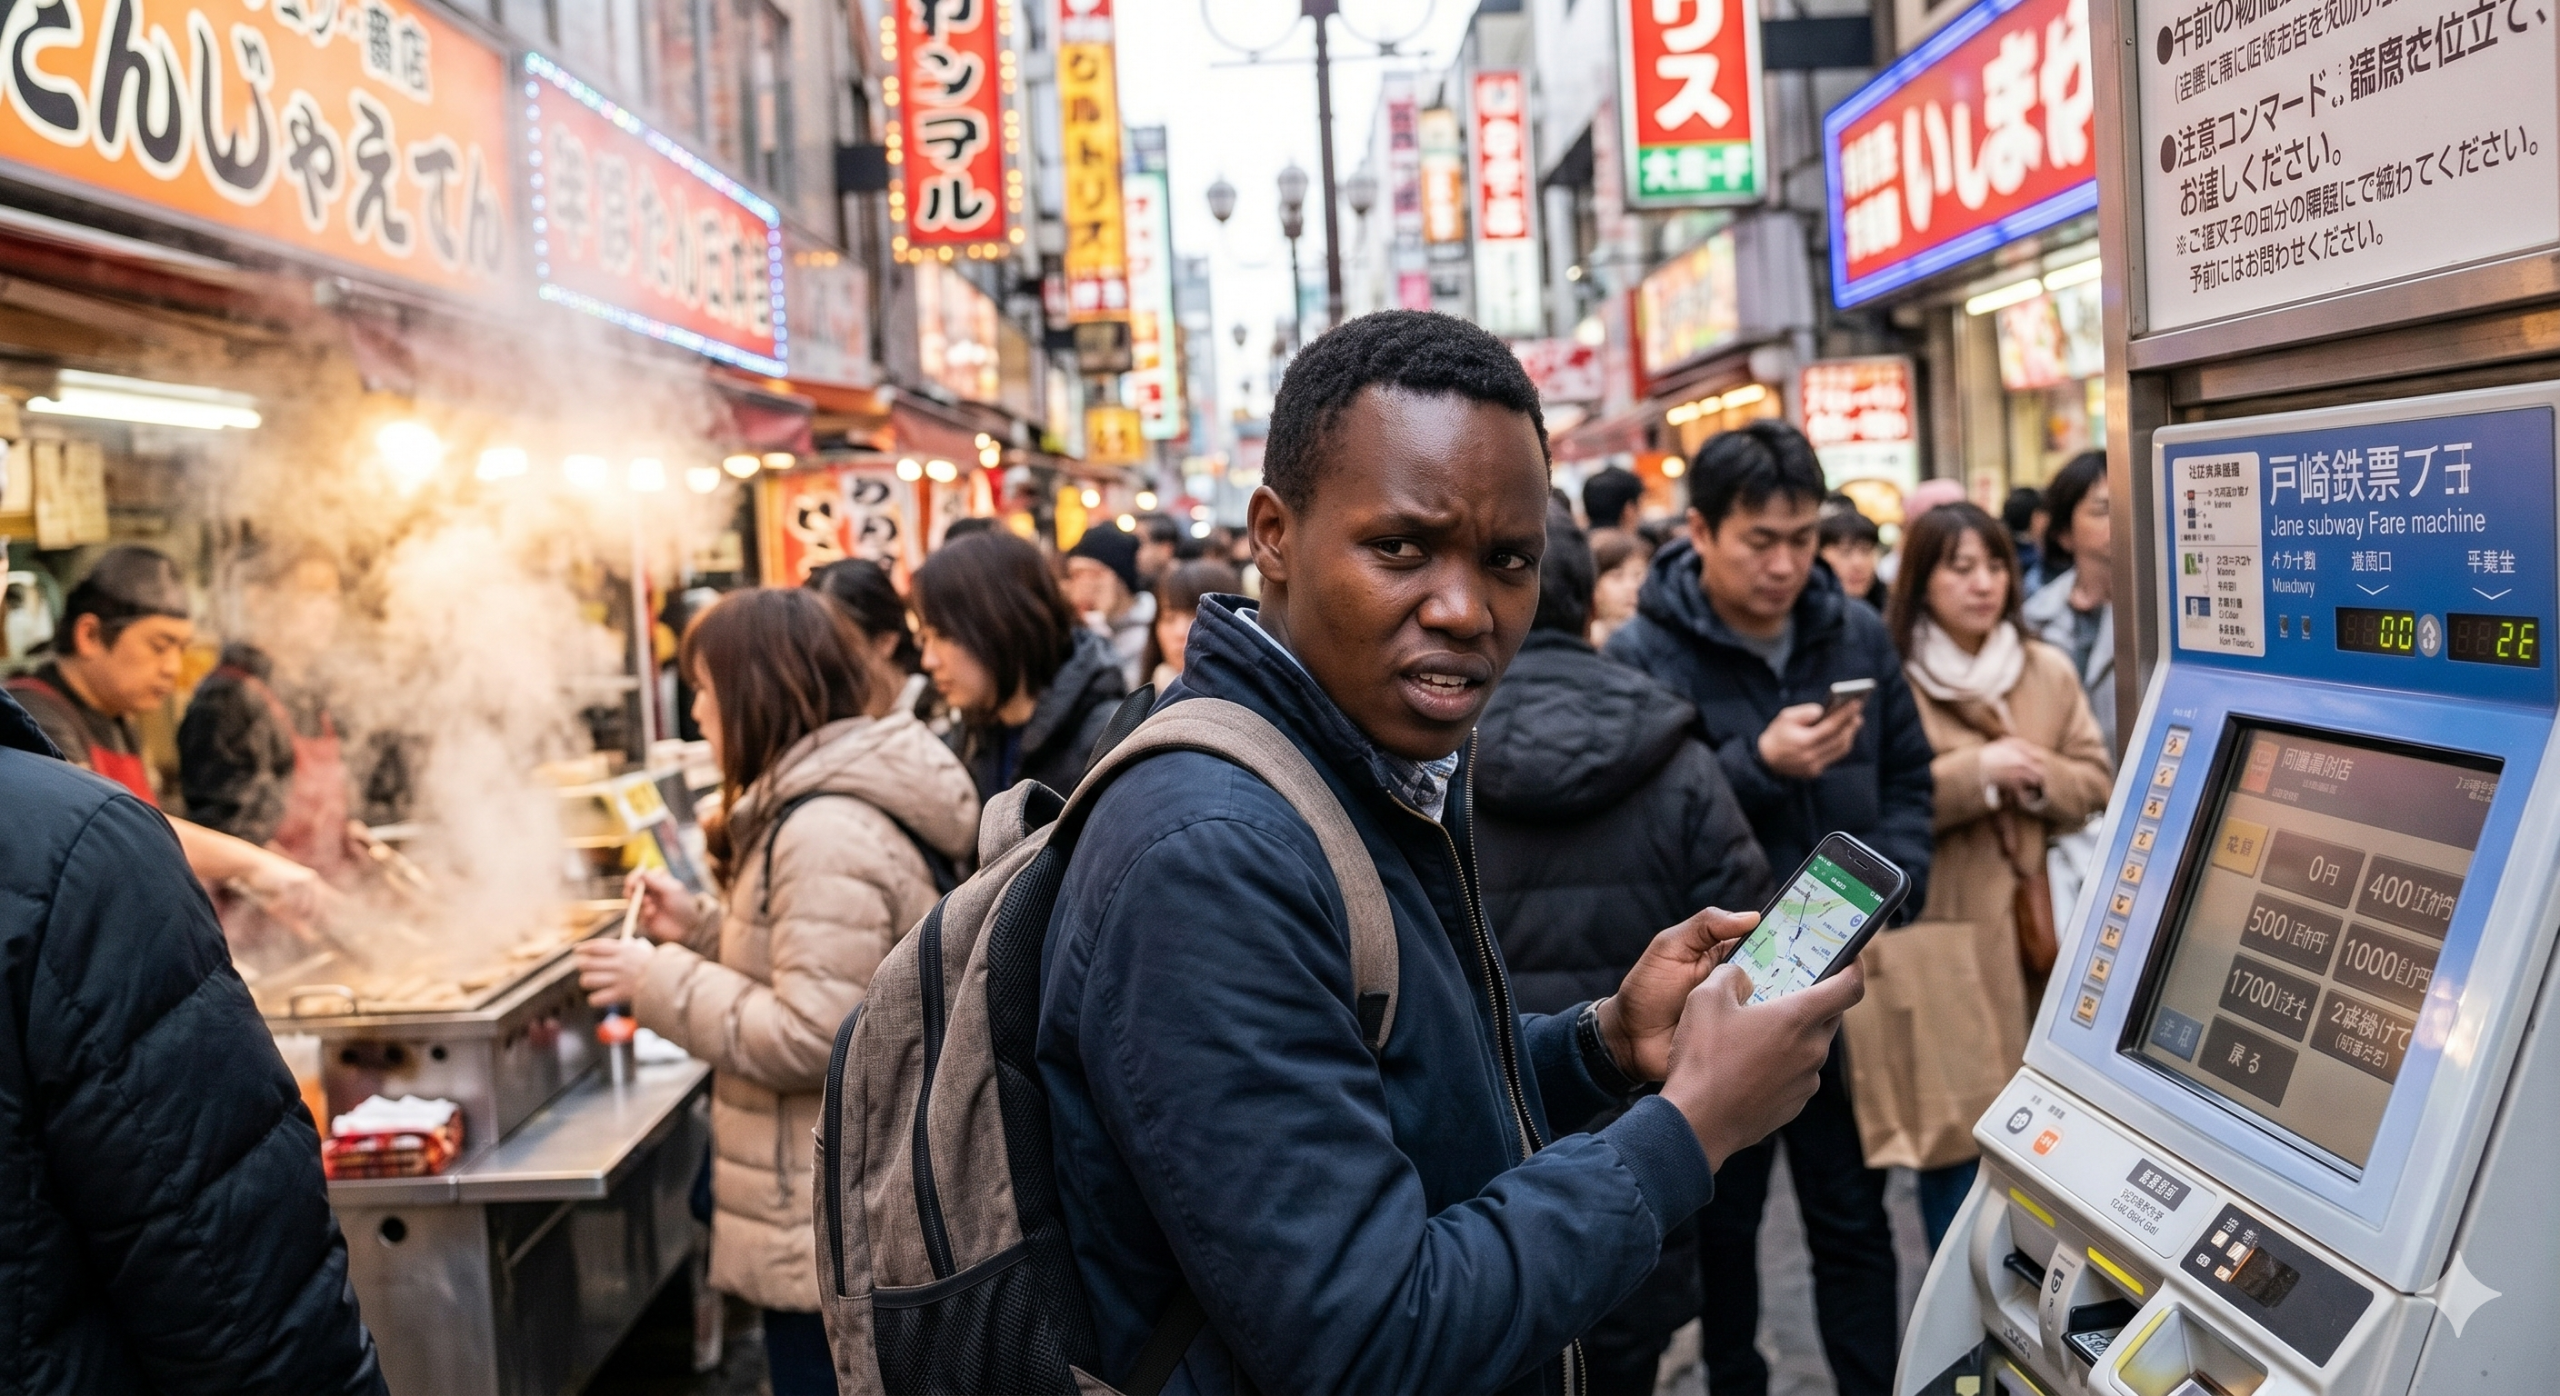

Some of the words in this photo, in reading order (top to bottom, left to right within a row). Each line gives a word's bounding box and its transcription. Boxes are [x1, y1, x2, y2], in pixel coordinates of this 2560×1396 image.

[2270, 514, 2304, 537] Jane
[2307, 512, 2365, 541] subway
[2369, 510, 2406, 535] Fare
[2411, 507, 2486, 534] machine
[2308, 855, 2341, 886] 0円
[2227, 1042, 2261, 1074] 戻る
